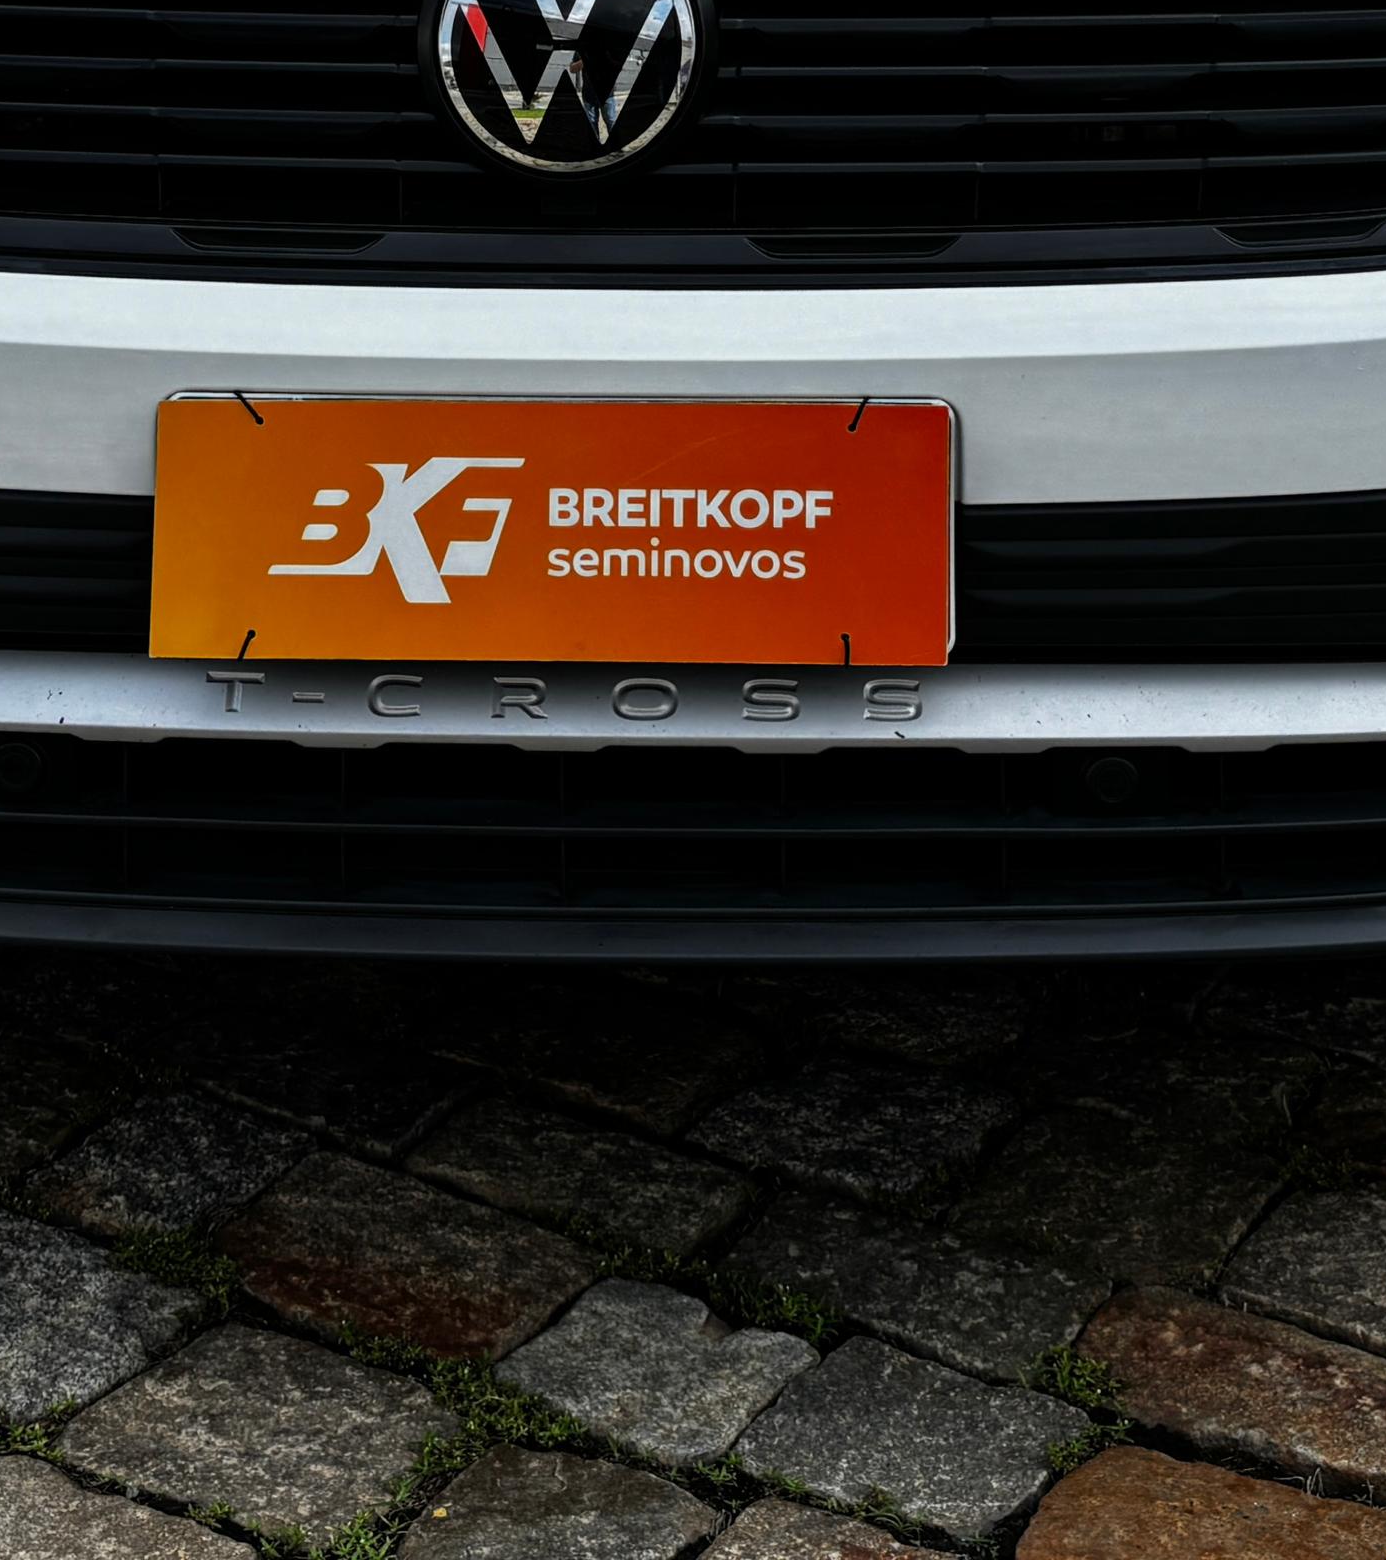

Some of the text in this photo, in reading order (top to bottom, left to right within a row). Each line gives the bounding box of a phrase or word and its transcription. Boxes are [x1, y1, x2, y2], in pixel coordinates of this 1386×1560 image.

[267, 456, 526, 604] BKF
[548, 487, 834, 529] BREITKOPF
[547, 536, 807, 579] seminovos
[205, 670, 924, 722] T-CROSS
